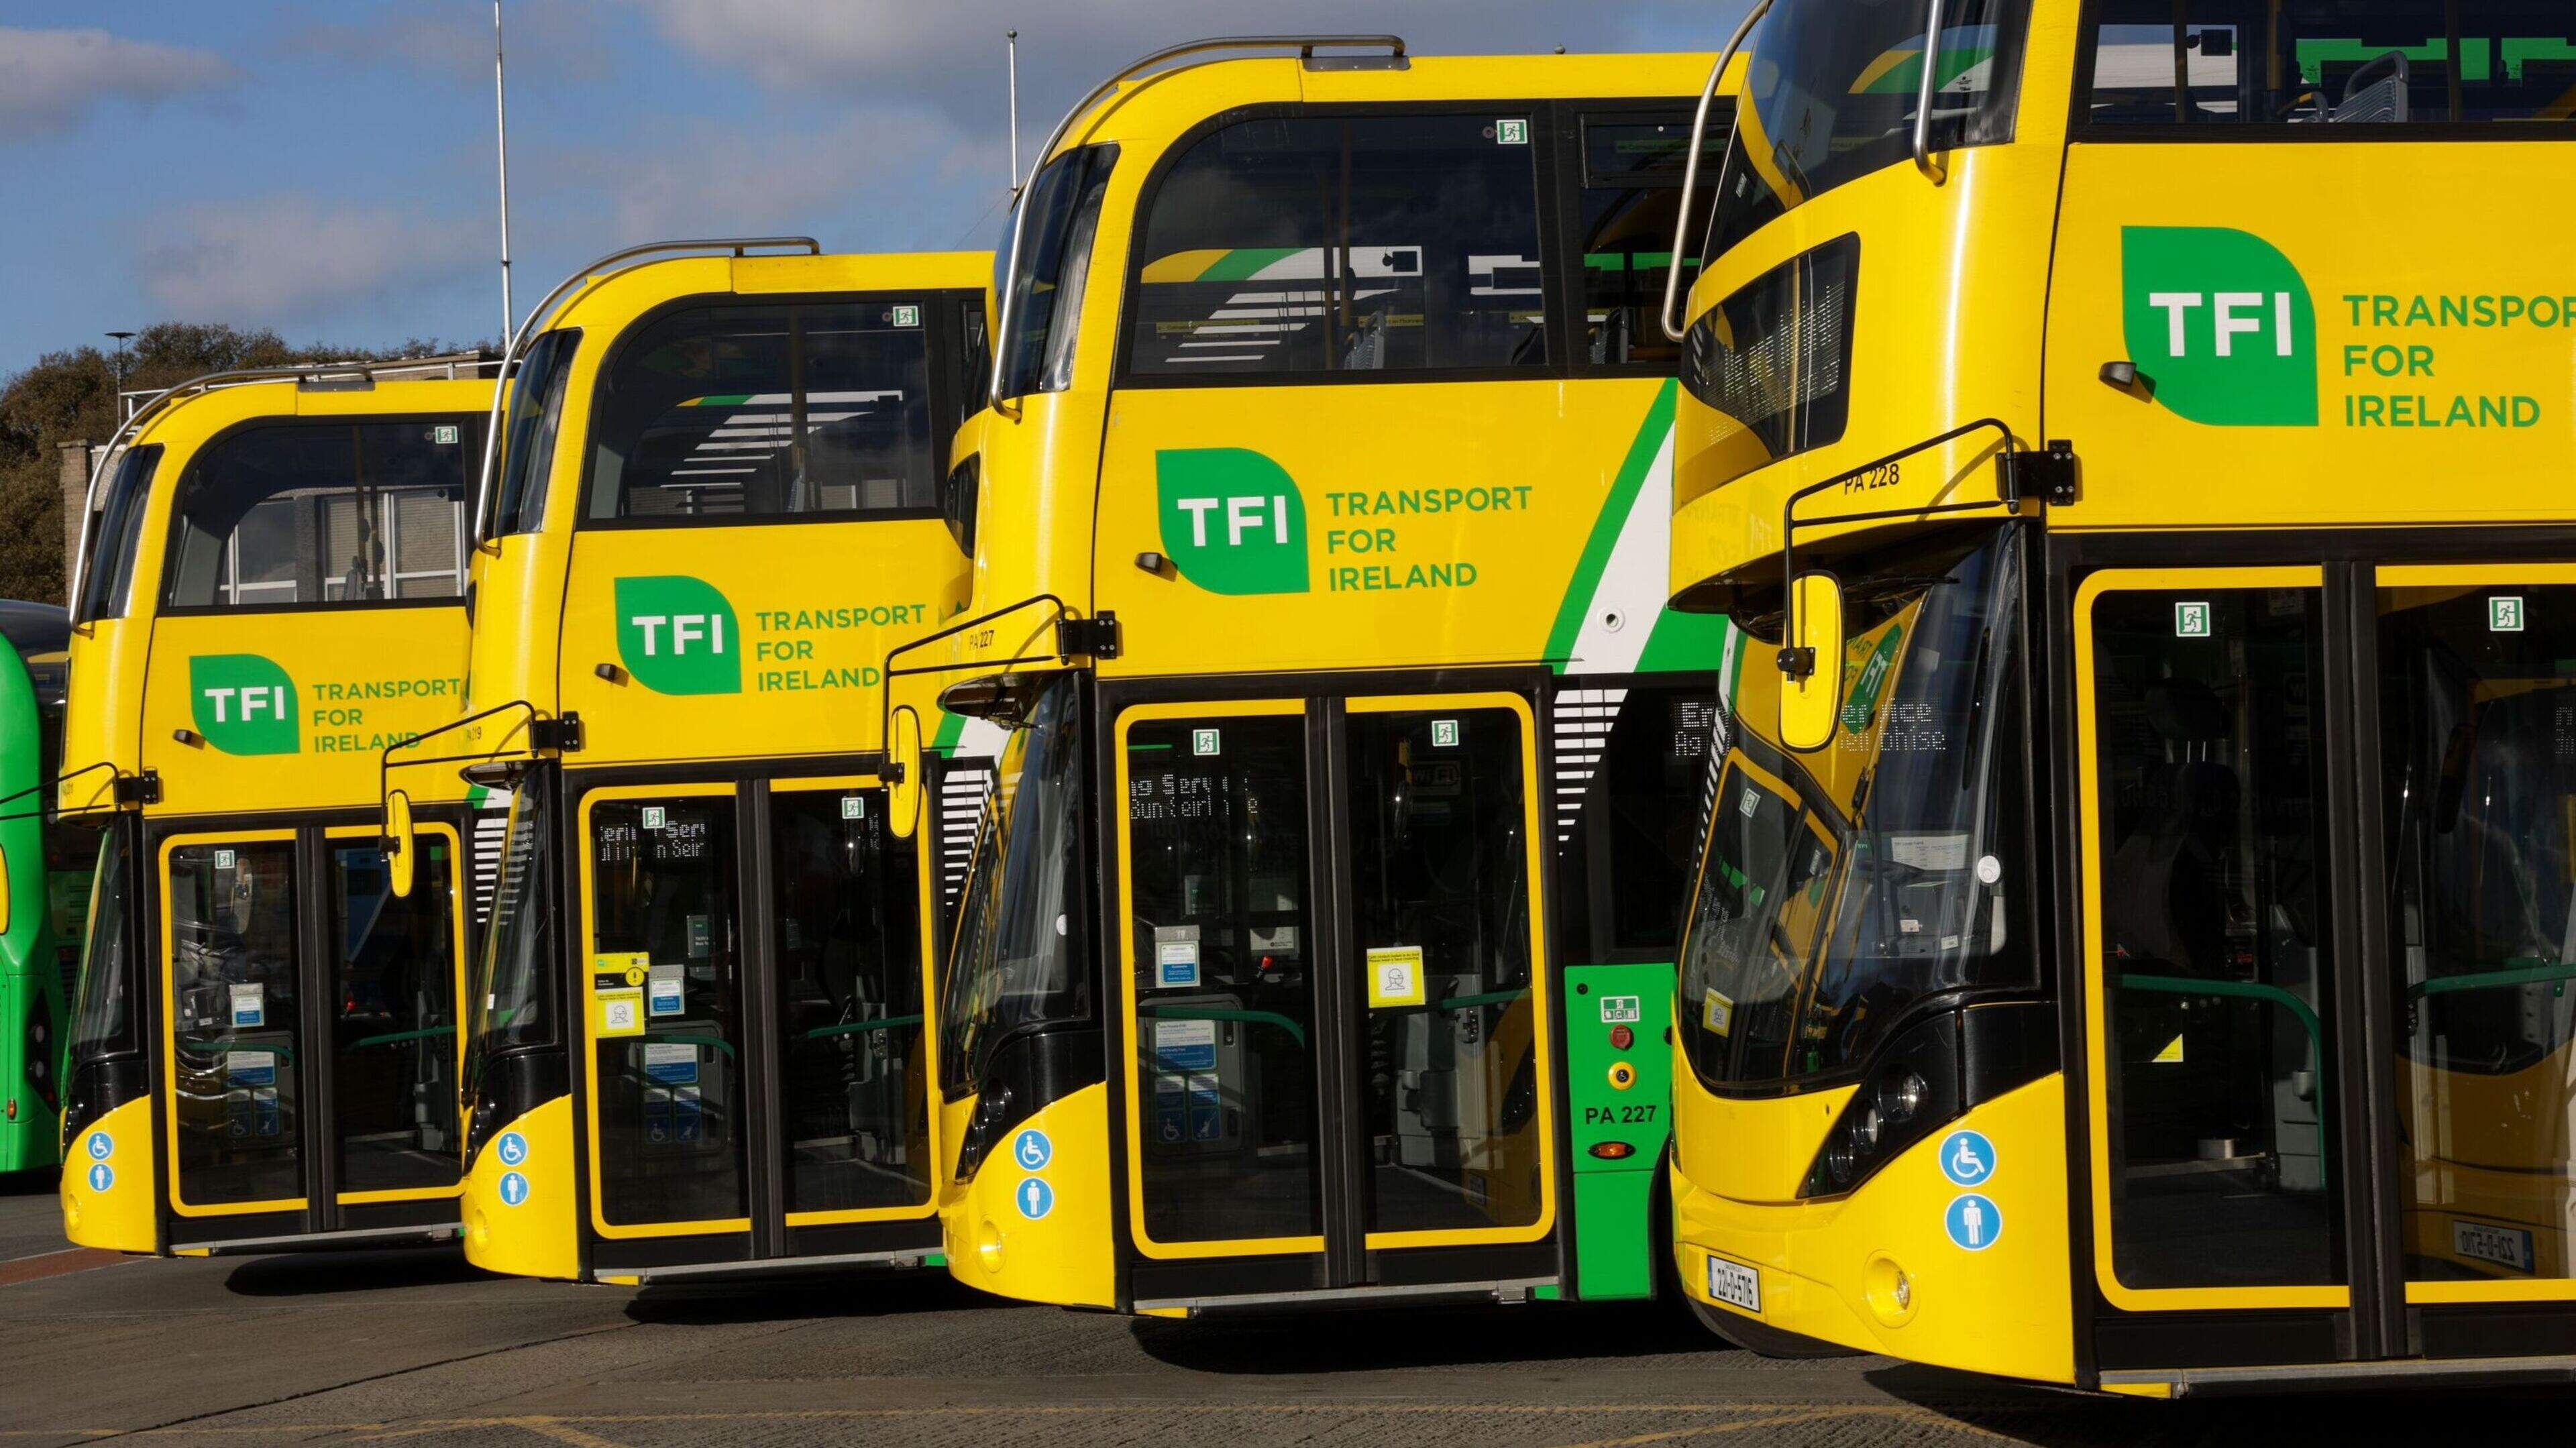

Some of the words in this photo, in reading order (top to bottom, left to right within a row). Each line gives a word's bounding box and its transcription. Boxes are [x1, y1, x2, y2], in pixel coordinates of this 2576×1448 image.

[2149, 292, 2293, 357] TFI
[2344, 344, 2435, 378] FOR
[2345, 394, 2541, 428] IRELAND
[1845, 475, 1865, 495] PA
[1869, 463, 1899, 490] 228
[1326, 486, 1533, 516] TRANSPORT
[1178, 495, 1289, 547] TFI
[1328, 528, 1396, 555] FOR
[1329, 563, 1479, 592] IRELAND
[756, 604, 927, 632] TRANSPORT
[632, 614, 724, 657] TFI
[979, 630, 994, 648] 227
[757, 641, 814, 662] FOR
[313, 678, 462, 700] TRANSPORT
[758, 667, 881, 691] IRELAND
[204, 686, 286, 723] TFI
[314, 709, 363, 727] FOR
[315, 732, 421, 753] IRELAND
[1585, 1107, 1615, 1125] PA
[1621, 1105, 1657, 1124] 227
